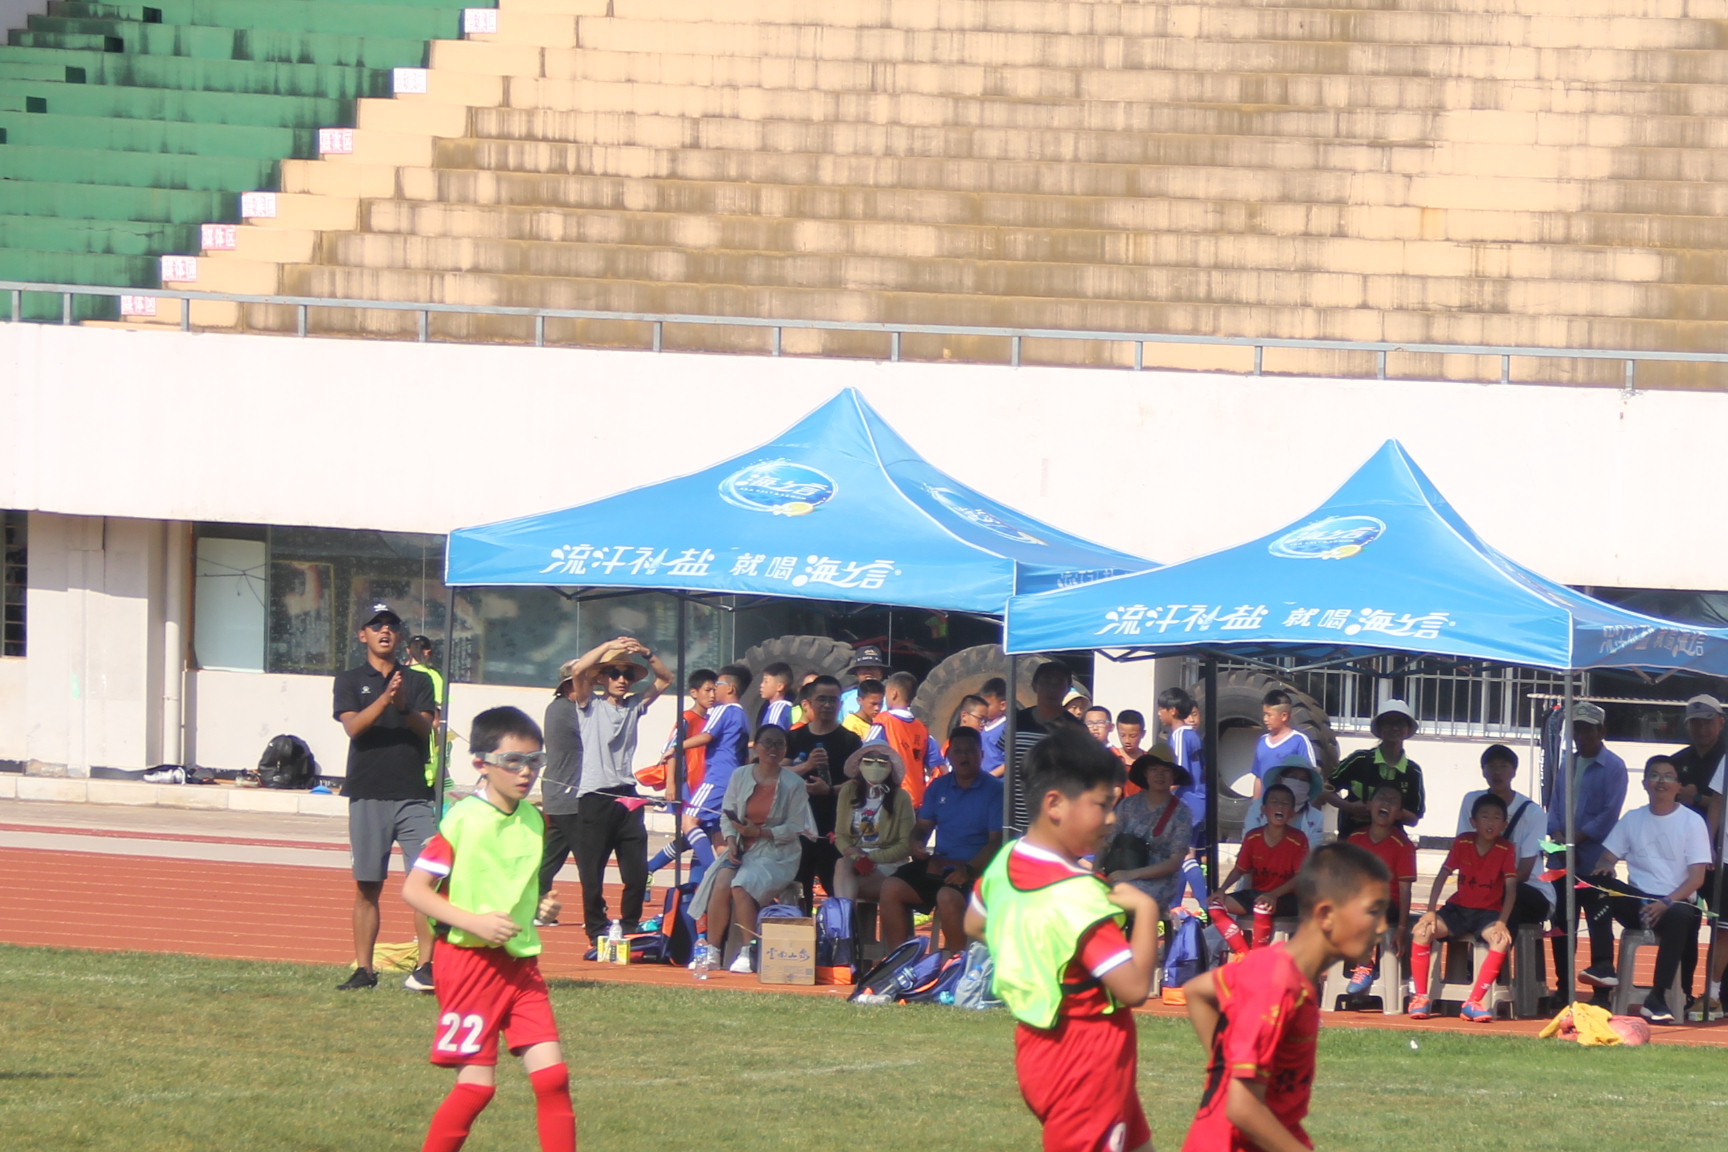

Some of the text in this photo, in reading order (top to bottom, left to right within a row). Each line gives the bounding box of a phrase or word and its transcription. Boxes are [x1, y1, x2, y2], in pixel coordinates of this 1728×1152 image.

[539, 543, 715, 577] 流汗补盐
[1094, 604, 1270, 636] 流汗补盐
[437, 1012, 484, 1053] 22
